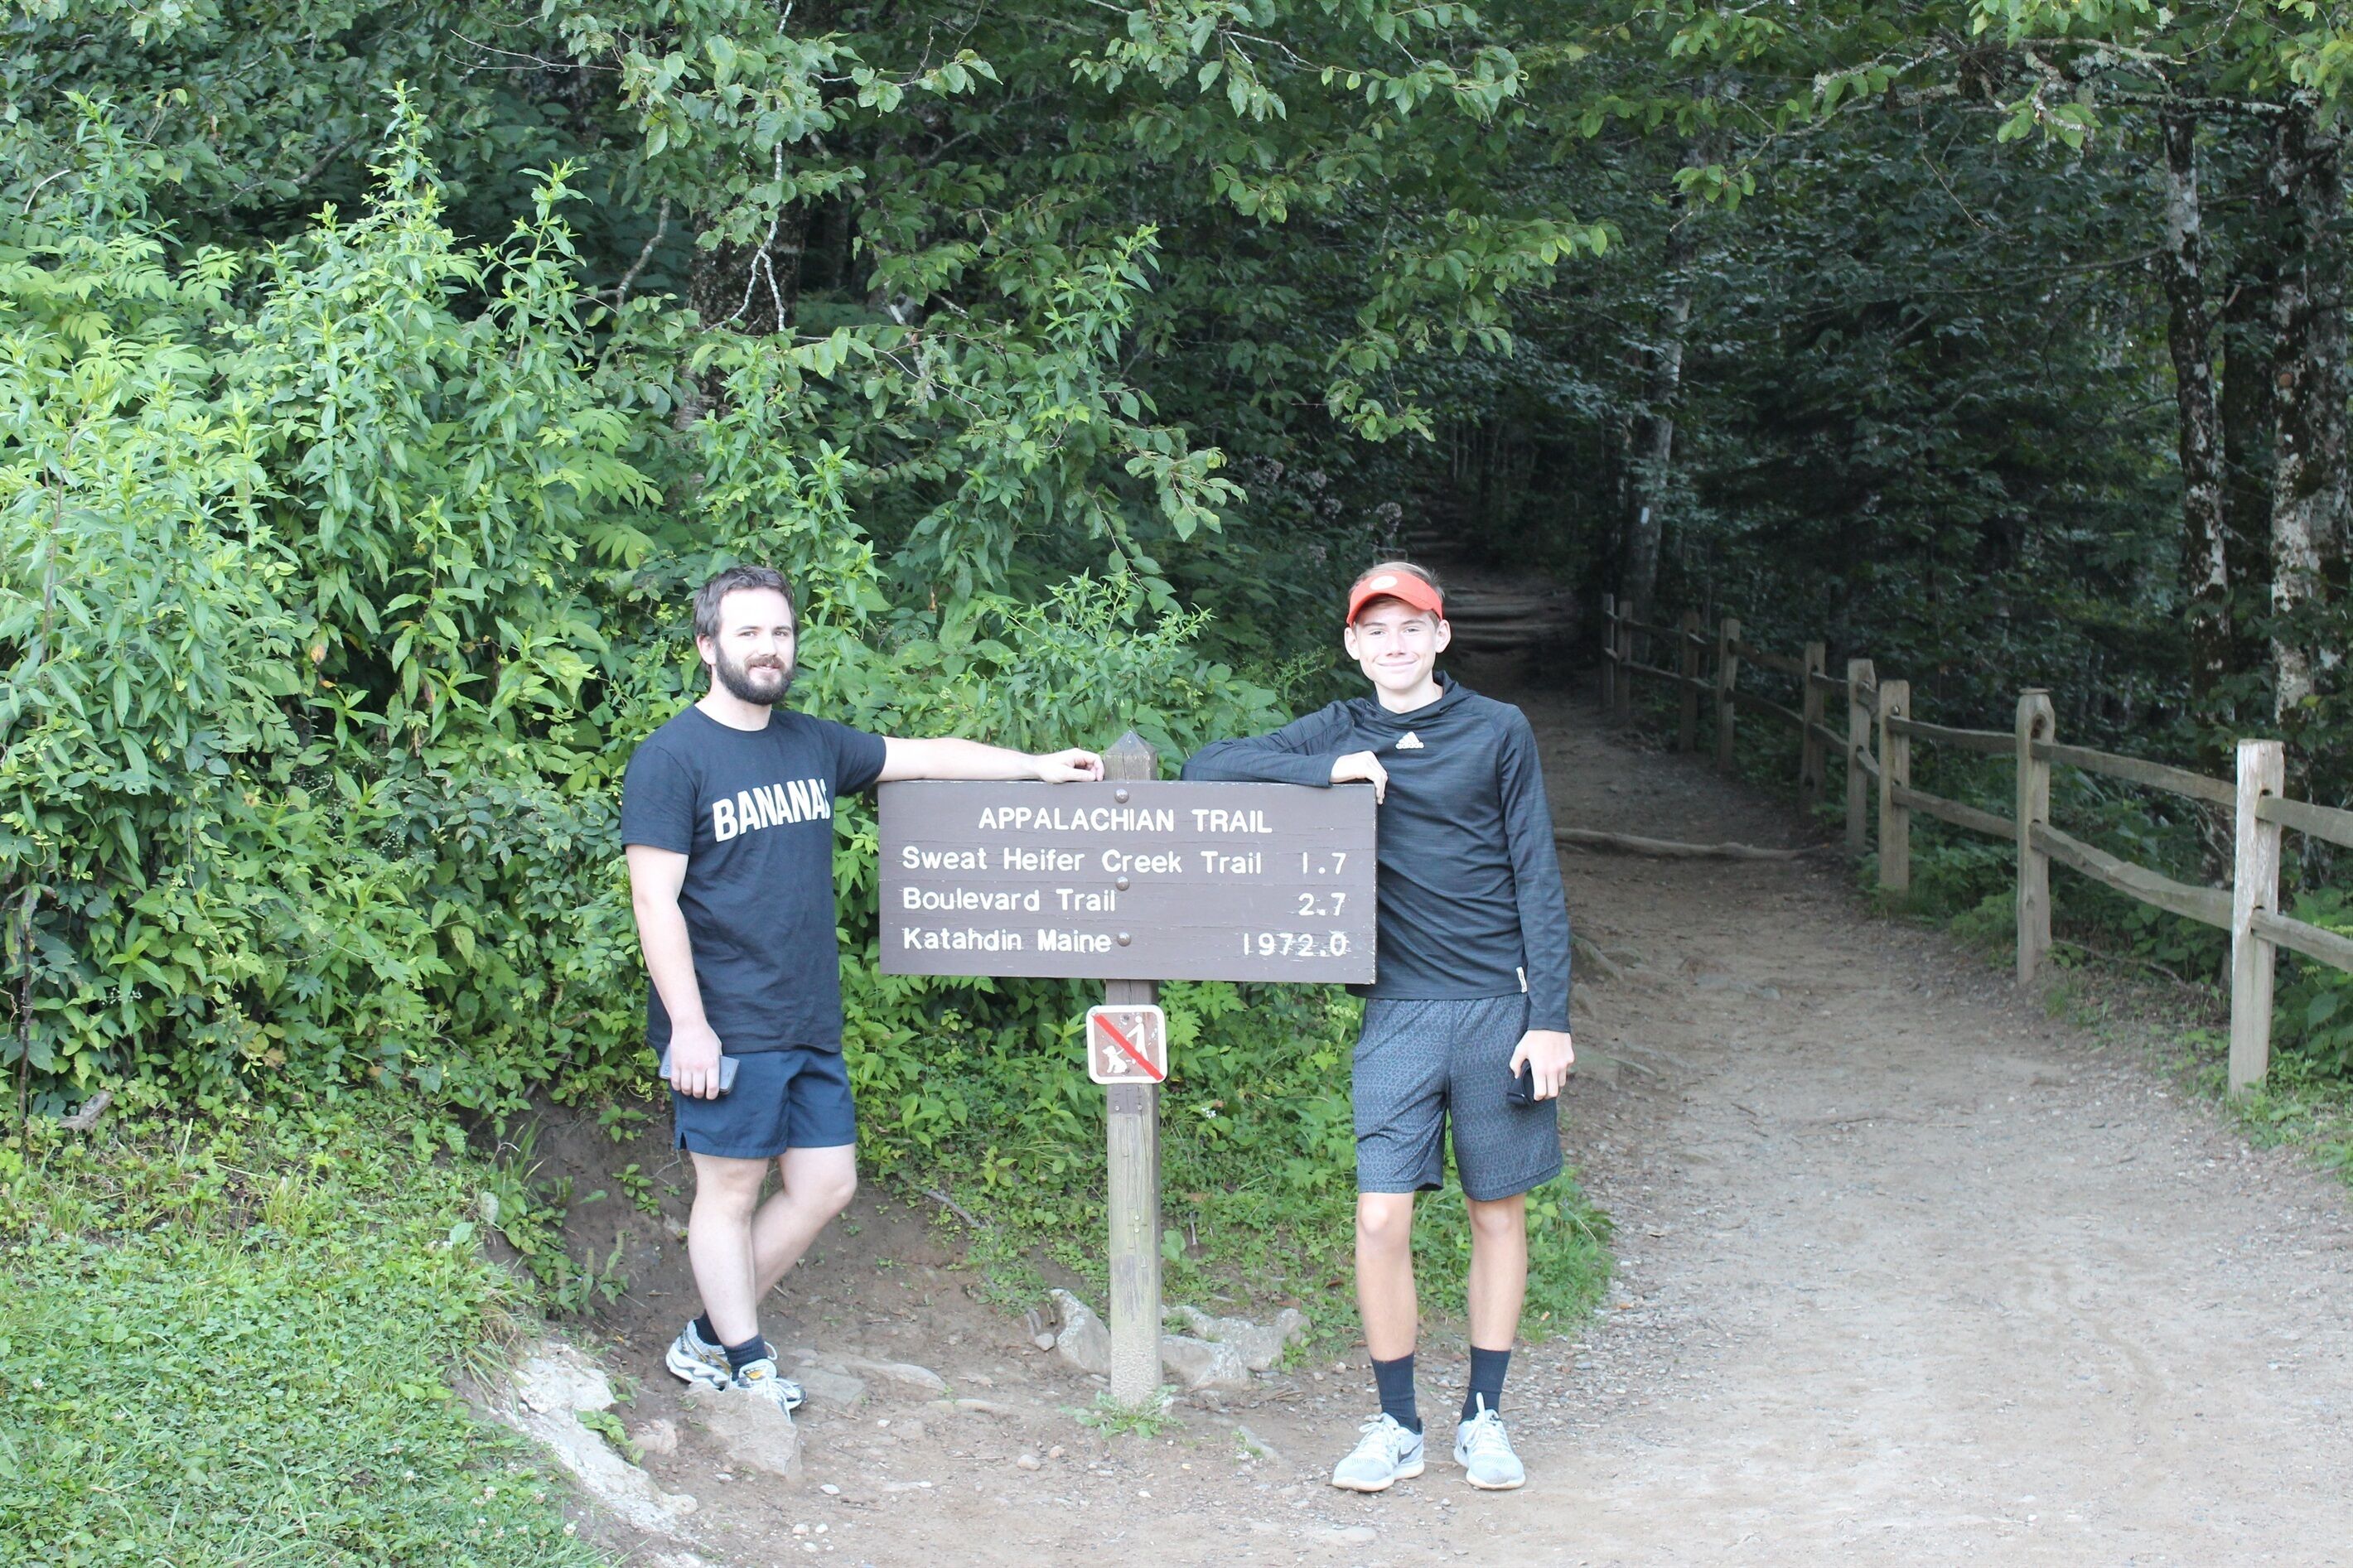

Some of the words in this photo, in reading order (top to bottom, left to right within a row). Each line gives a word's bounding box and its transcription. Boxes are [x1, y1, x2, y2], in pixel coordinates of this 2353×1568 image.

[978, 807, 1174, 832] APPALACHIAN
[1191, 808, 1273, 833] TRAIL
[902, 846, 988, 870] Sweat
[1003, 847, 1085, 871] Heifer
[1101, 848, 1182, 874] Creek
[1200, 851, 1262, 875] Trail
[1302, 851, 1347, 876] 1.7
[903, 886, 1040, 912] Boulevard
[1056, 888, 1115, 912] Trail
[1298, 892, 1346, 917] 2.7
[904, 927, 1022, 952] Katahdin
[1037, 929, 1113, 953] Maine
[1243, 931, 1349, 957] 1972.0
